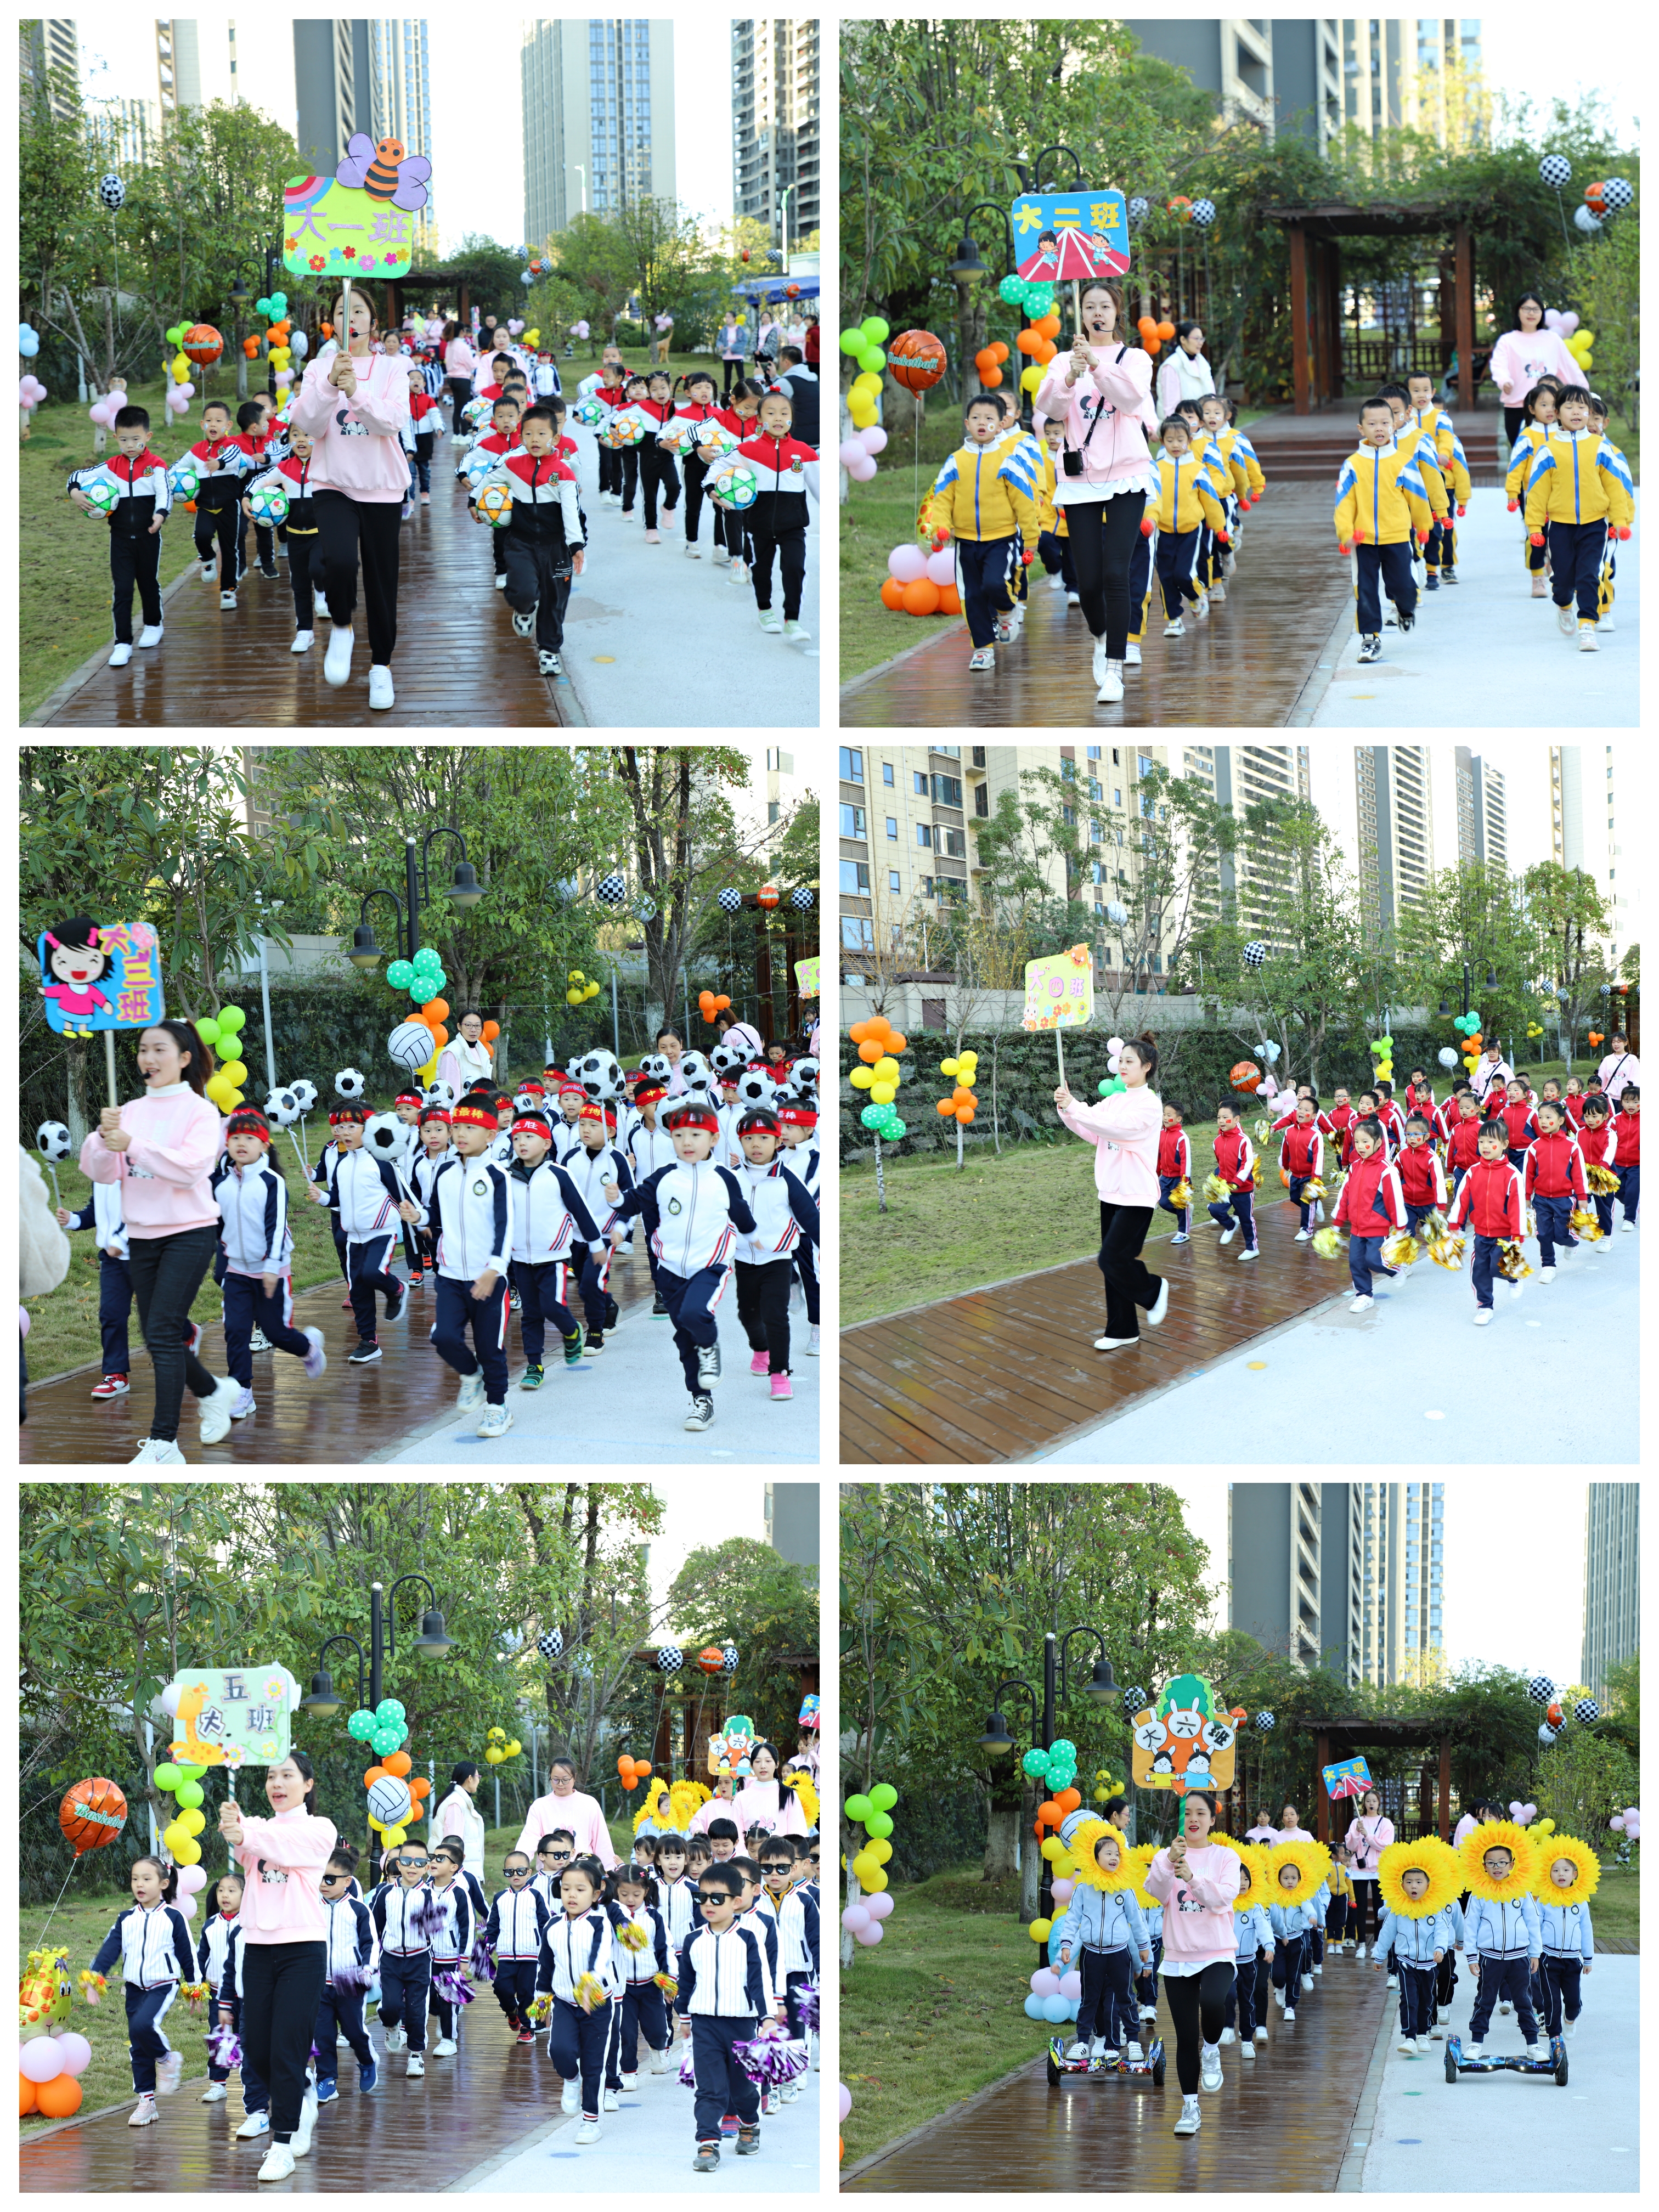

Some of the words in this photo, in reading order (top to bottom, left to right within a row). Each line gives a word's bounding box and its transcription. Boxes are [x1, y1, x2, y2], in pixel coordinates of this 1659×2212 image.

[289, 201, 410, 246] 大一班
[1013, 202, 1120, 235] 大二班
[888, 351, 939, 369] Basketball
[100, 925, 155, 1022] 大三班
[1028, 964, 1085, 998] 大四班
[646, 1086, 667, 1097] 中国
[714, 1737, 756, 1754] 大六
[1143, 1716, 1231, 1747] 大六班
[1323, 1761, 1365, 1782] 大二班
